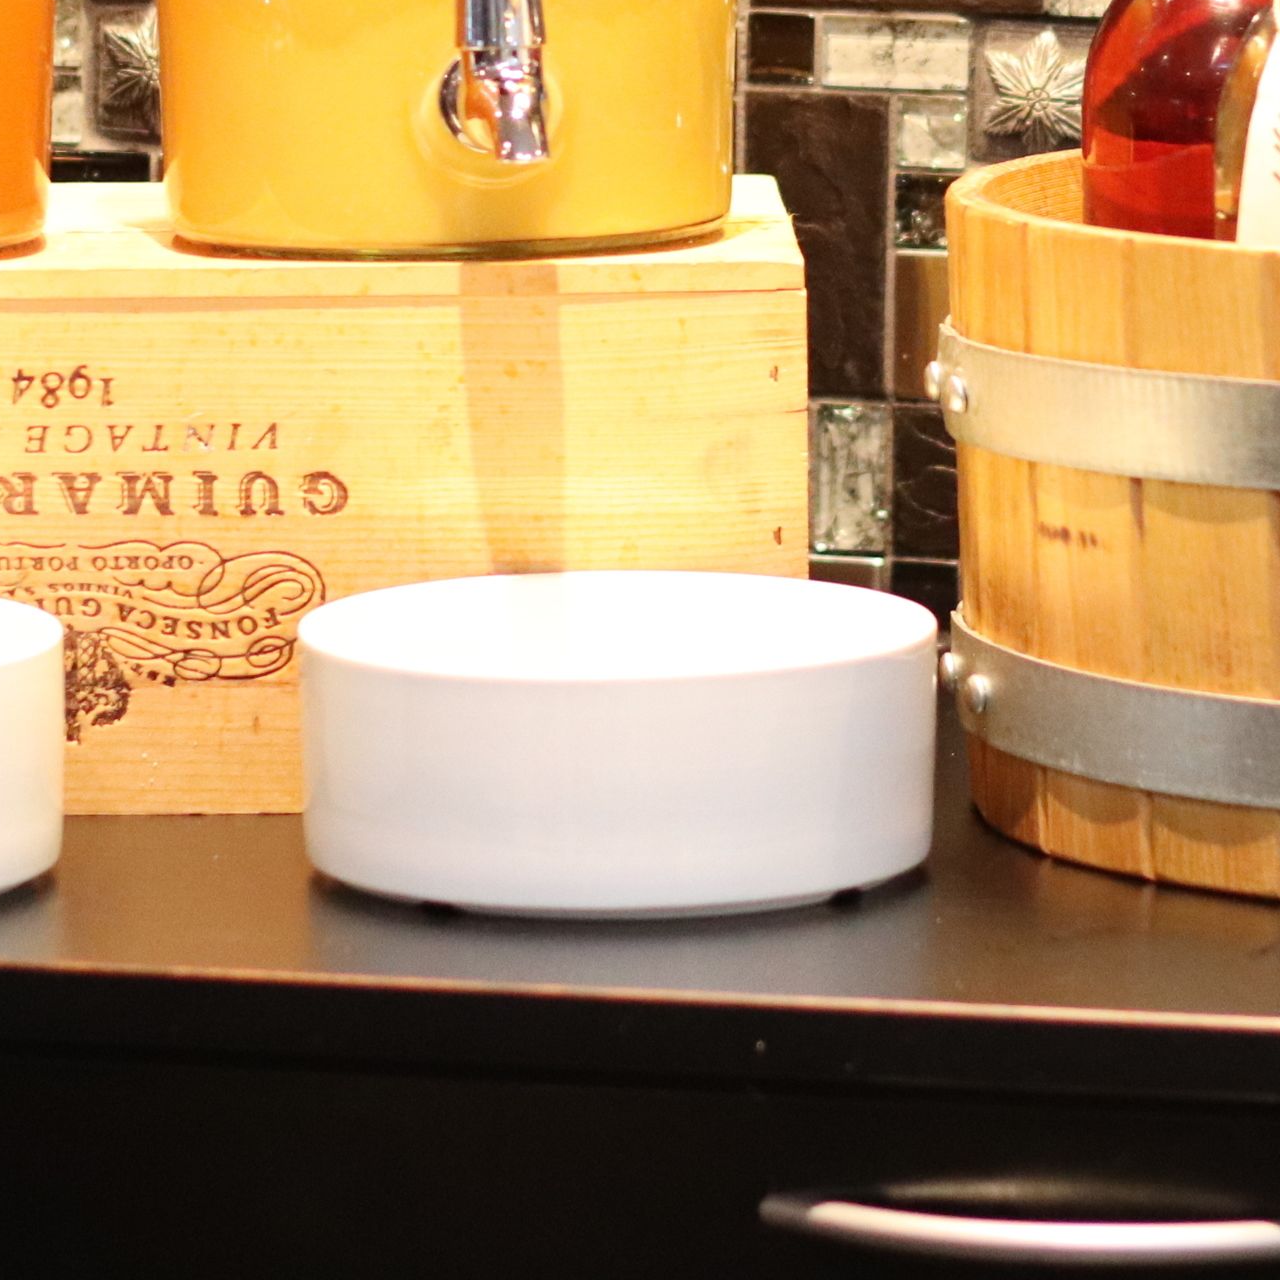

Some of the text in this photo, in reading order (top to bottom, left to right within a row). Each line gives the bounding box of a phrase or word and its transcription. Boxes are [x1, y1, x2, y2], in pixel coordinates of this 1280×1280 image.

[11, 364, 115, 408] 1984
[25, 421, 279, 455] VINTAGE
[47, 582, 135, 599] VINHOS
[117, 601, 283, 640] FONSECA
